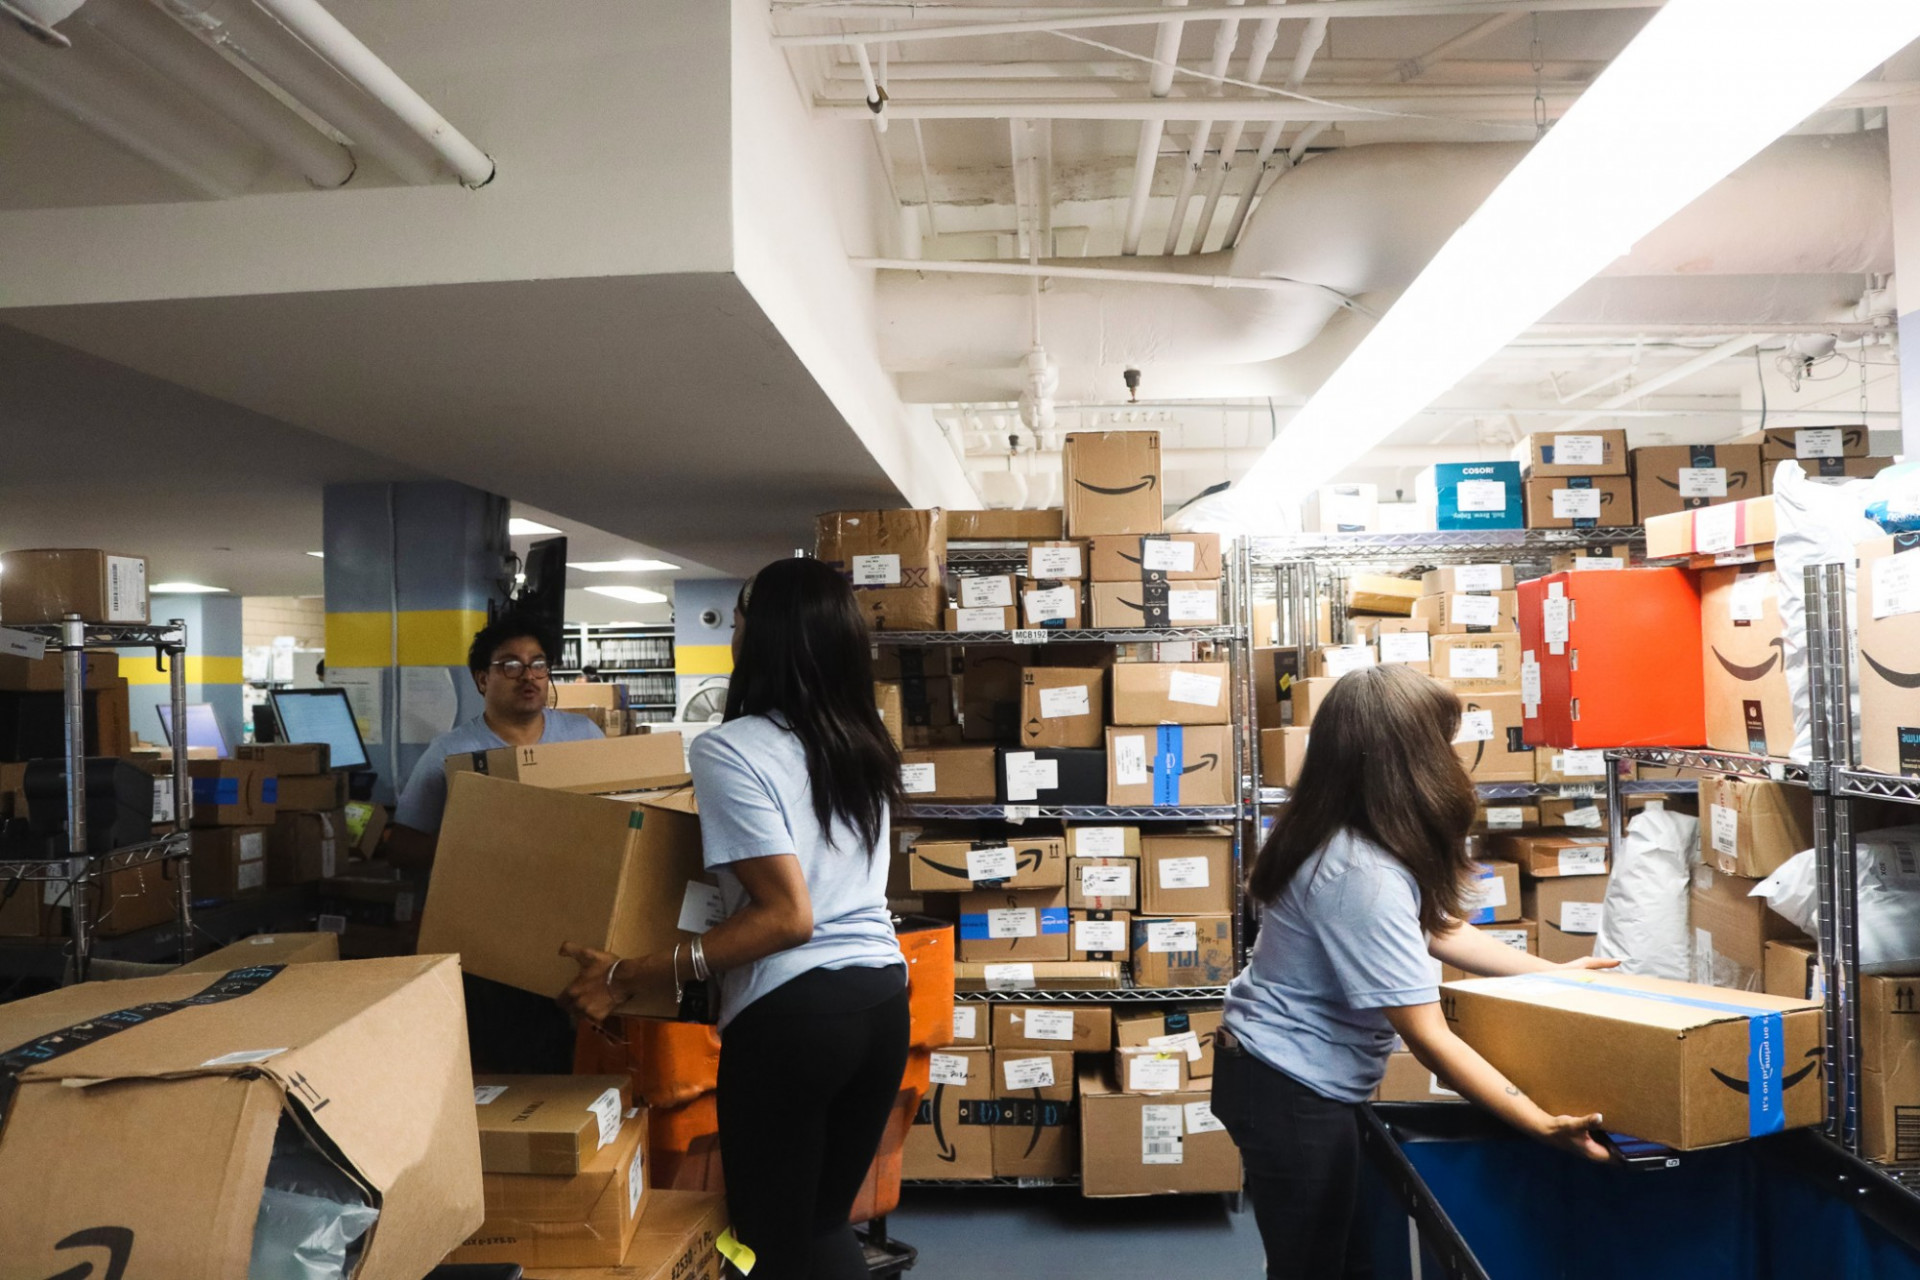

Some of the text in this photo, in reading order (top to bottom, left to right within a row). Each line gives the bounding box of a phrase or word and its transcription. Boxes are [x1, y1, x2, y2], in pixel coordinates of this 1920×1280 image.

[1462, 466, 1495, 475] COSORI
[1015, 631, 1047, 639] MCB192
[1168, 944, 1199, 968] FIJI
